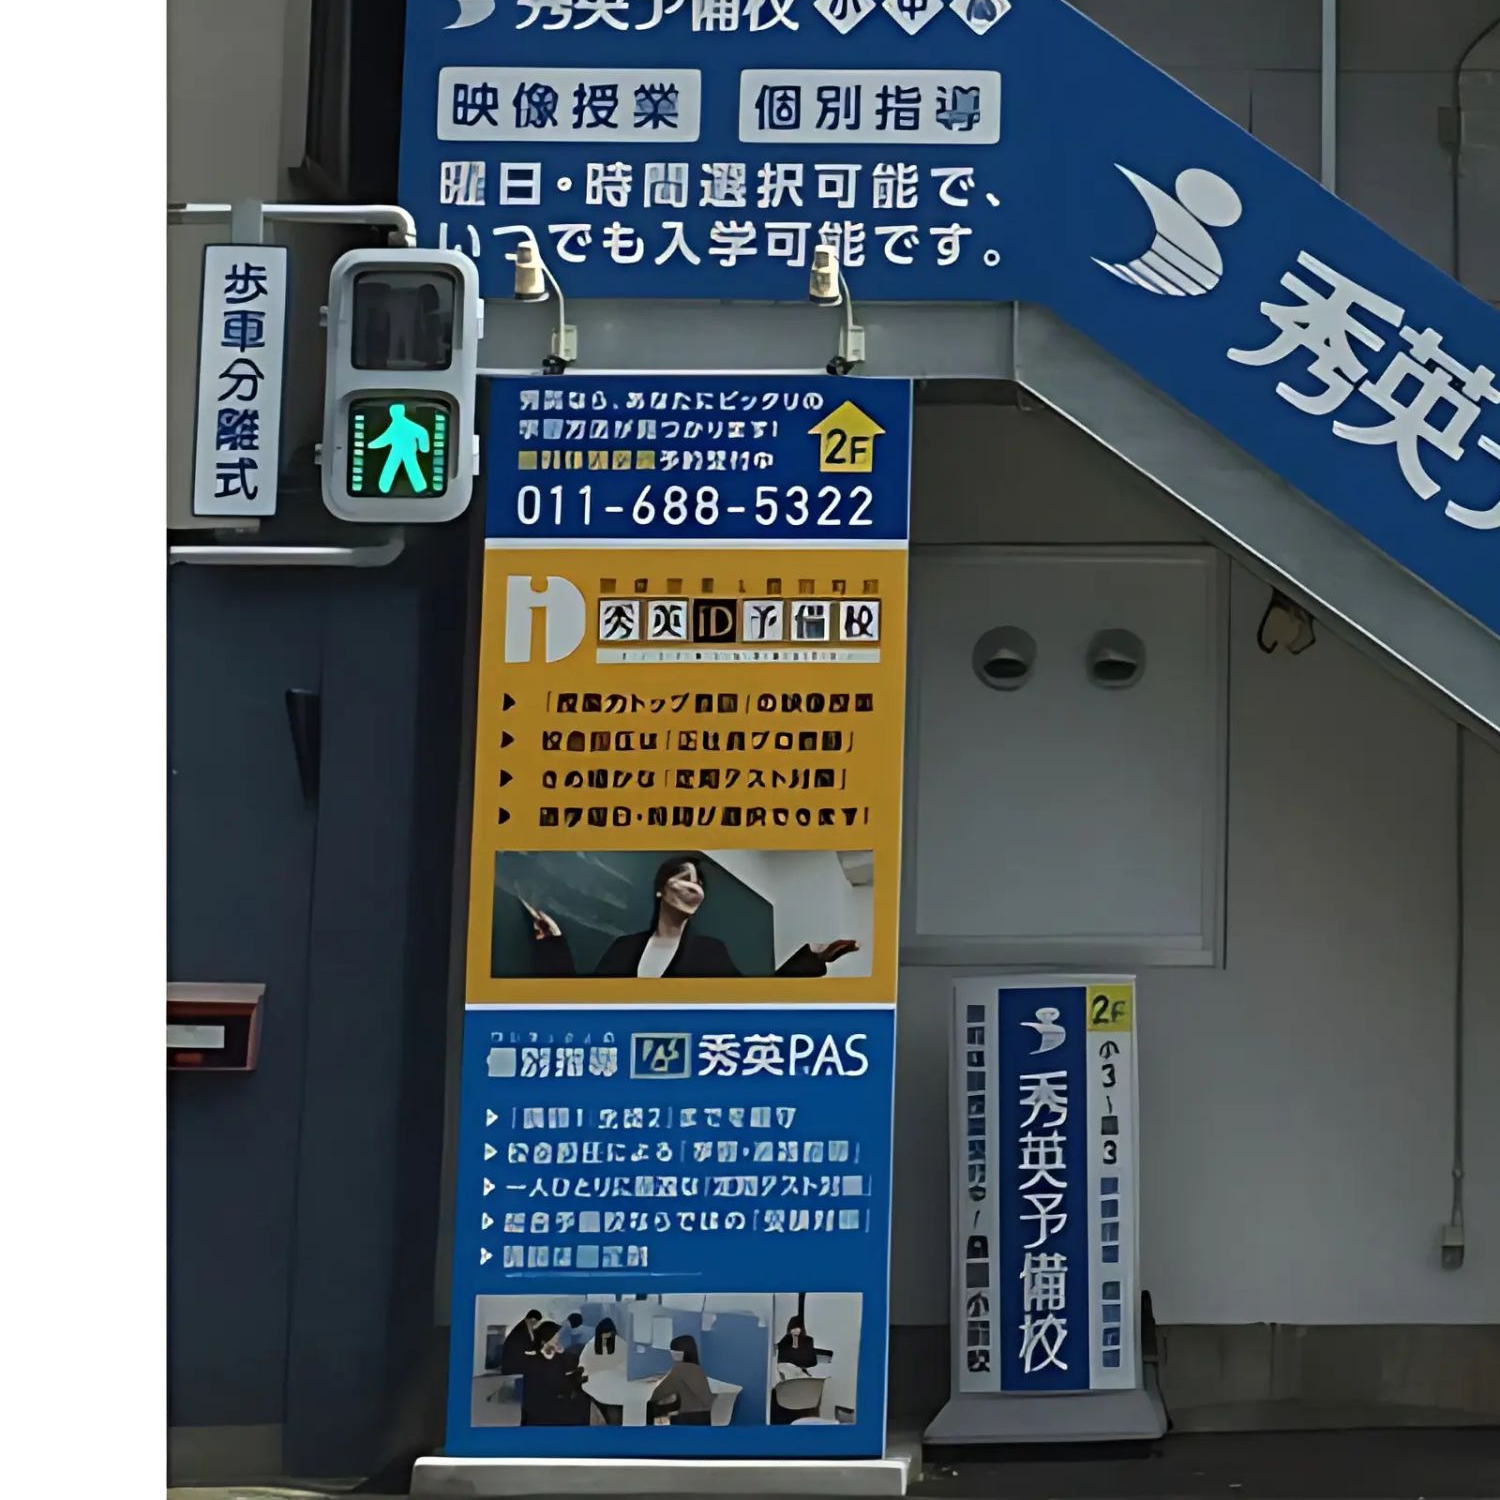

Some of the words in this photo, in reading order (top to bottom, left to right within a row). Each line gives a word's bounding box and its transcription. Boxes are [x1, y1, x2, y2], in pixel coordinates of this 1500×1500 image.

[452, 82, 680, 130] 映像授業
[755, 84, 981, 132] 個別指導
[214, 262, 268, 501] 歩車分離式
[824, 427, 870, 465] 2F
[517, 484, 873, 526] 011-688-5322
[1092, 994, 1126, 1025] 2F
[698, 1033, 869, 1077] 秀英PAS
[1019, 1070, 1069, 1373] 秀英予備校
